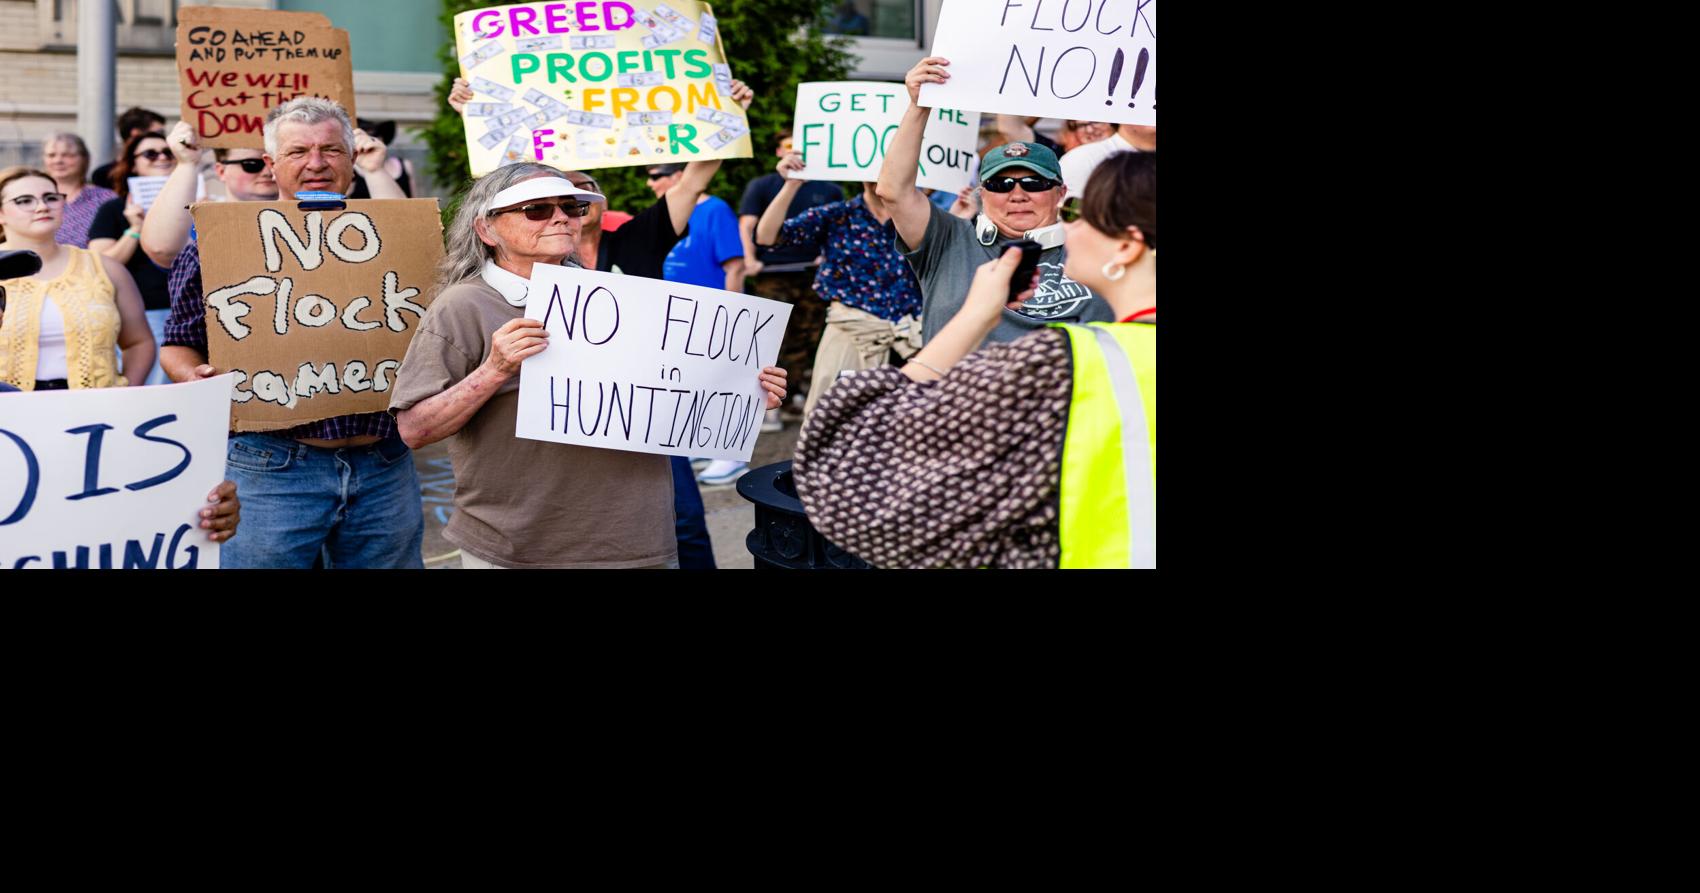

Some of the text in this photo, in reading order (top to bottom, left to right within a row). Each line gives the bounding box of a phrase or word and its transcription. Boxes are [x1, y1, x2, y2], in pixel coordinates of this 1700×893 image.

[188, 26, 305, 46] GO AHEAD
[472, 1, 636, 39] GREED
[1000, 0, 1156, 38] FLOCK
[189, 48, 226, 62] AND
[234, 49, 268, 61] PUT
[322, 48, 342, 60] UP
[511, 49, 713, 84] PROFITS
[186, 68, 239, 88] We
[999, 44, 1156, 110] NO!!
[187, 90, 253, 109] Cut
[582, 81, 722, 119] FROM
[819, 92, 968, 126] GET HE
[927, 144, 973, 172] OUT
[257, 208, 382, 273] NO
[206, 270, 427, 341] Flock
[543, 284, 774, 369] NO FLOCK
[231, 359, 400, 406] camer
[661, 364, 681, 382] in
[550, 376, 760, 451] HUNTINGTON
[65, 413, 192, 500] IS
